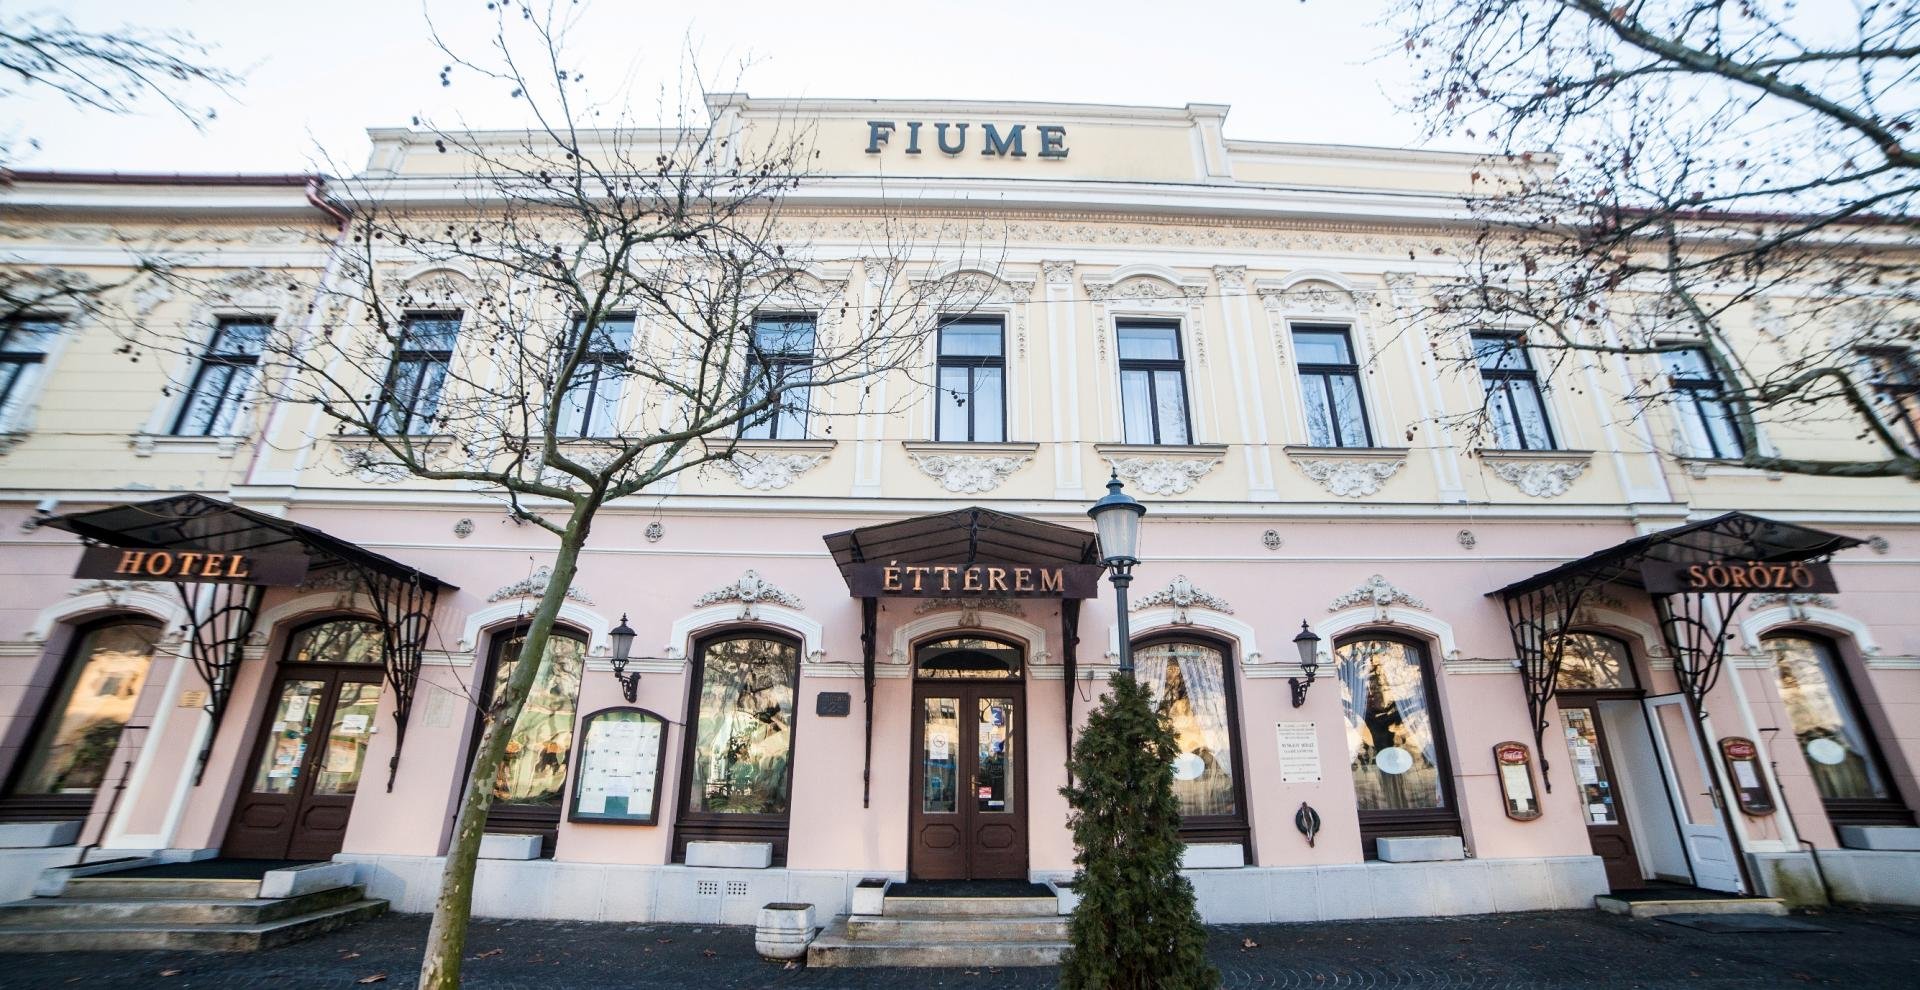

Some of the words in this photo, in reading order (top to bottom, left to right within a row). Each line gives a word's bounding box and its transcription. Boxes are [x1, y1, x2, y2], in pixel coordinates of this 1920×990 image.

[865, 121, 1070, 158] FIUME
[115, 551, 249, 578] HOTEL
[882, 560, 1065, 592] ÉTTEREM
